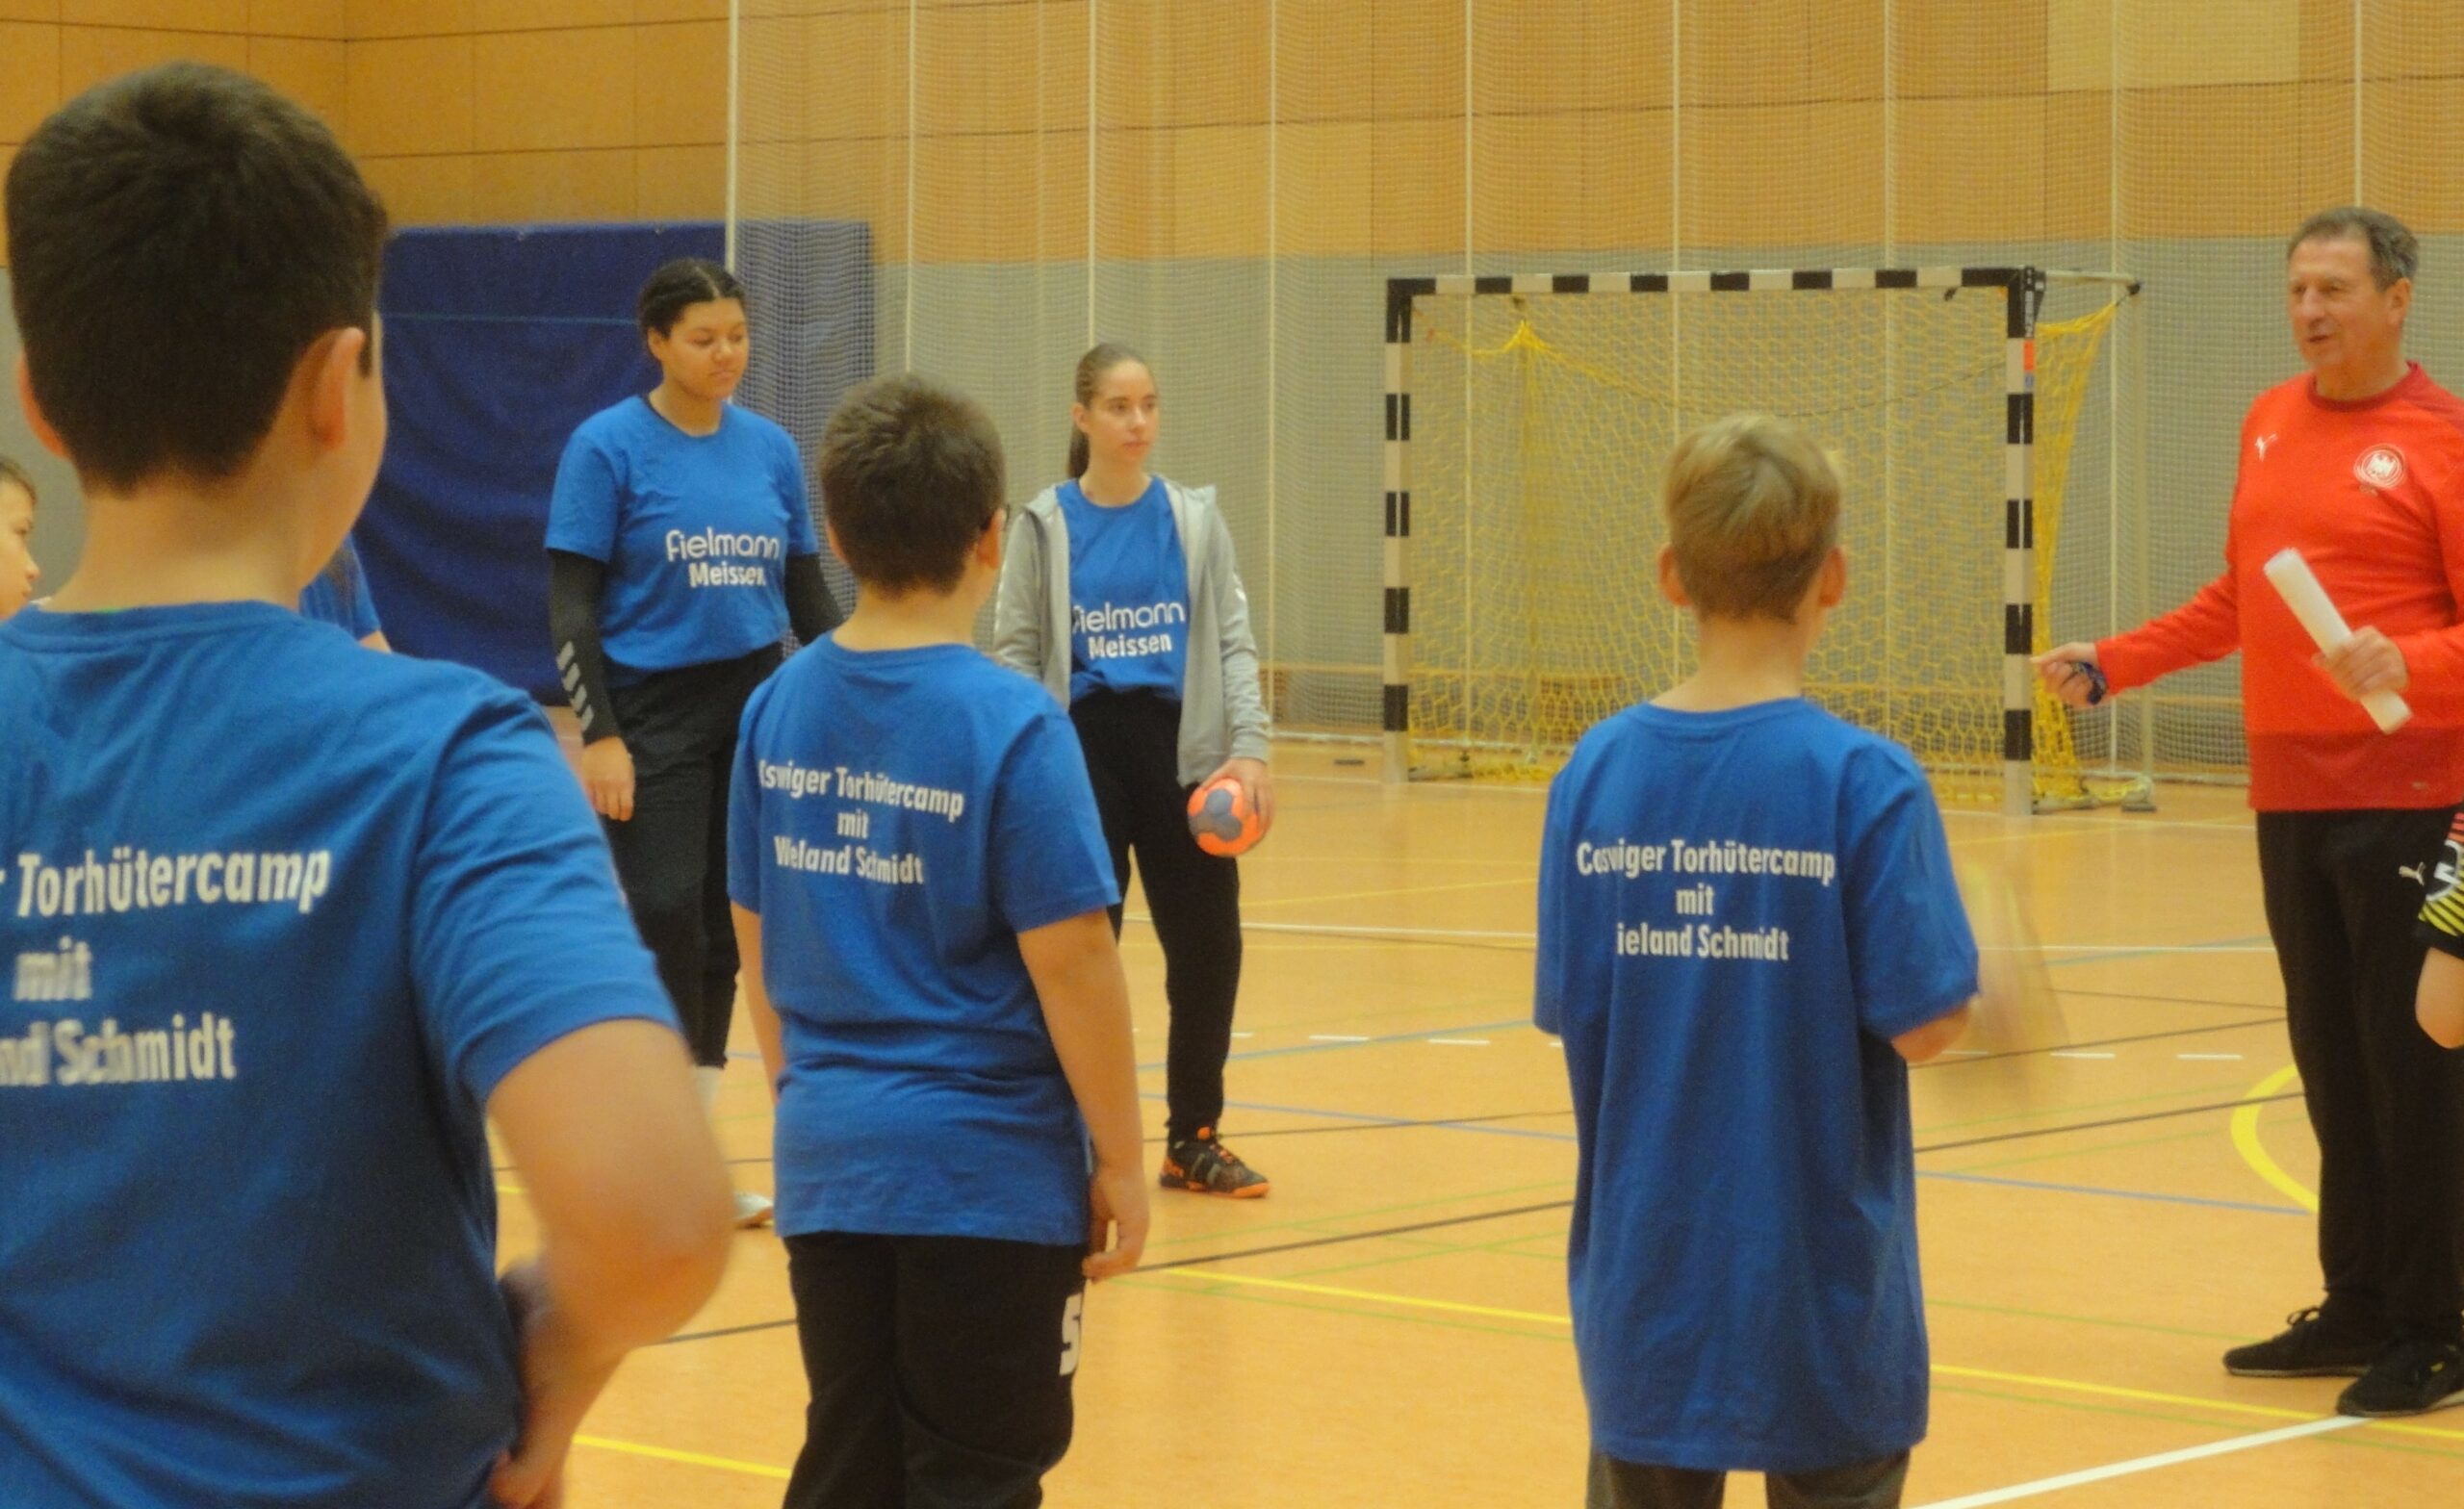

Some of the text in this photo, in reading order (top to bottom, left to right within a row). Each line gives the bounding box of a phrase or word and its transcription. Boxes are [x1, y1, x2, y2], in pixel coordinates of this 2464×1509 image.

[1088, 633, 1172, 660] Meissen
[836, 808, 869, 840] mit
[16, 846, 332, 918] Torhütercamp
[1671, 838, 1836, 887] Torhütercamp
[1676, 882, 1715, 915] mit
[1616, 922, 1789, 961] ieland Schmidt
[13, 935, 93, 1002] mit
[54, 1011, 237, 1086] Schmidt
